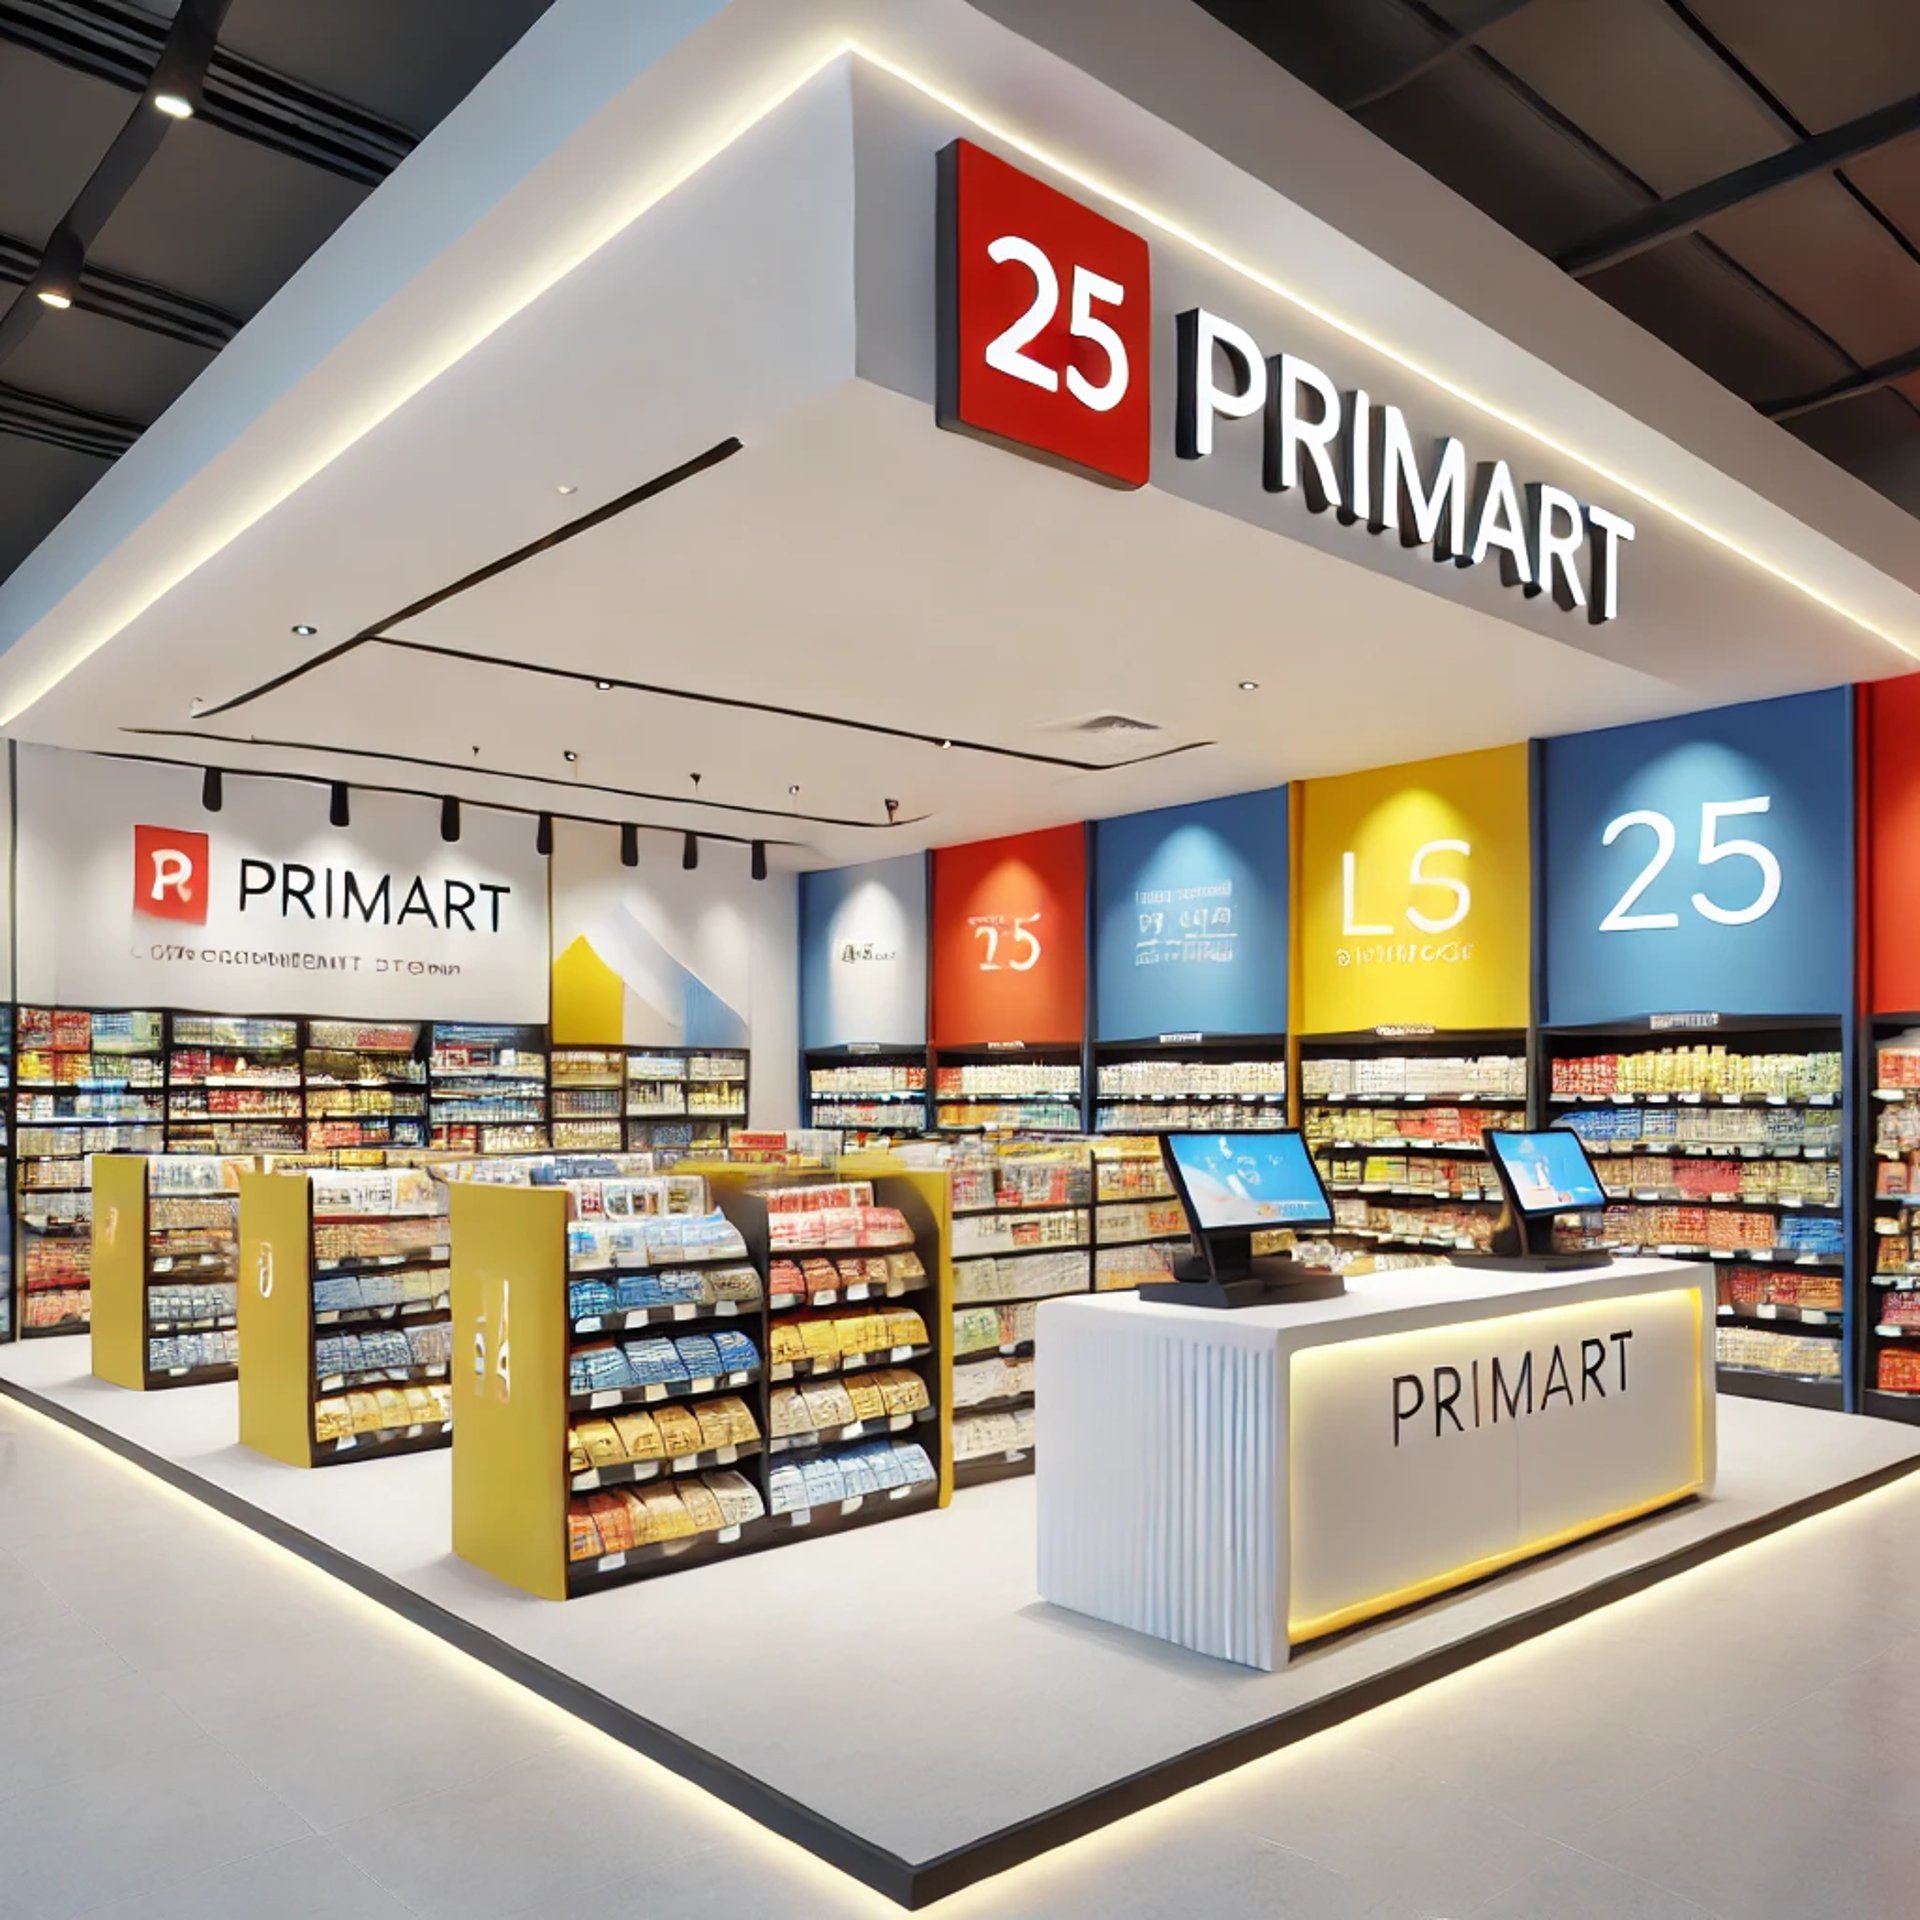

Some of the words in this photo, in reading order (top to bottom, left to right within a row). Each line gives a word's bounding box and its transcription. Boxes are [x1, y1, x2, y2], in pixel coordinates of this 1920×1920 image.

[985, 235, 1129, 412] 25
[1194, 307, 1636, 620] PRIMART
[239, 858, 511, 933] PRIMART
[1598, 796, 1782, 932] 25
[1392, 1329, 1634, 1448] PRIMART
